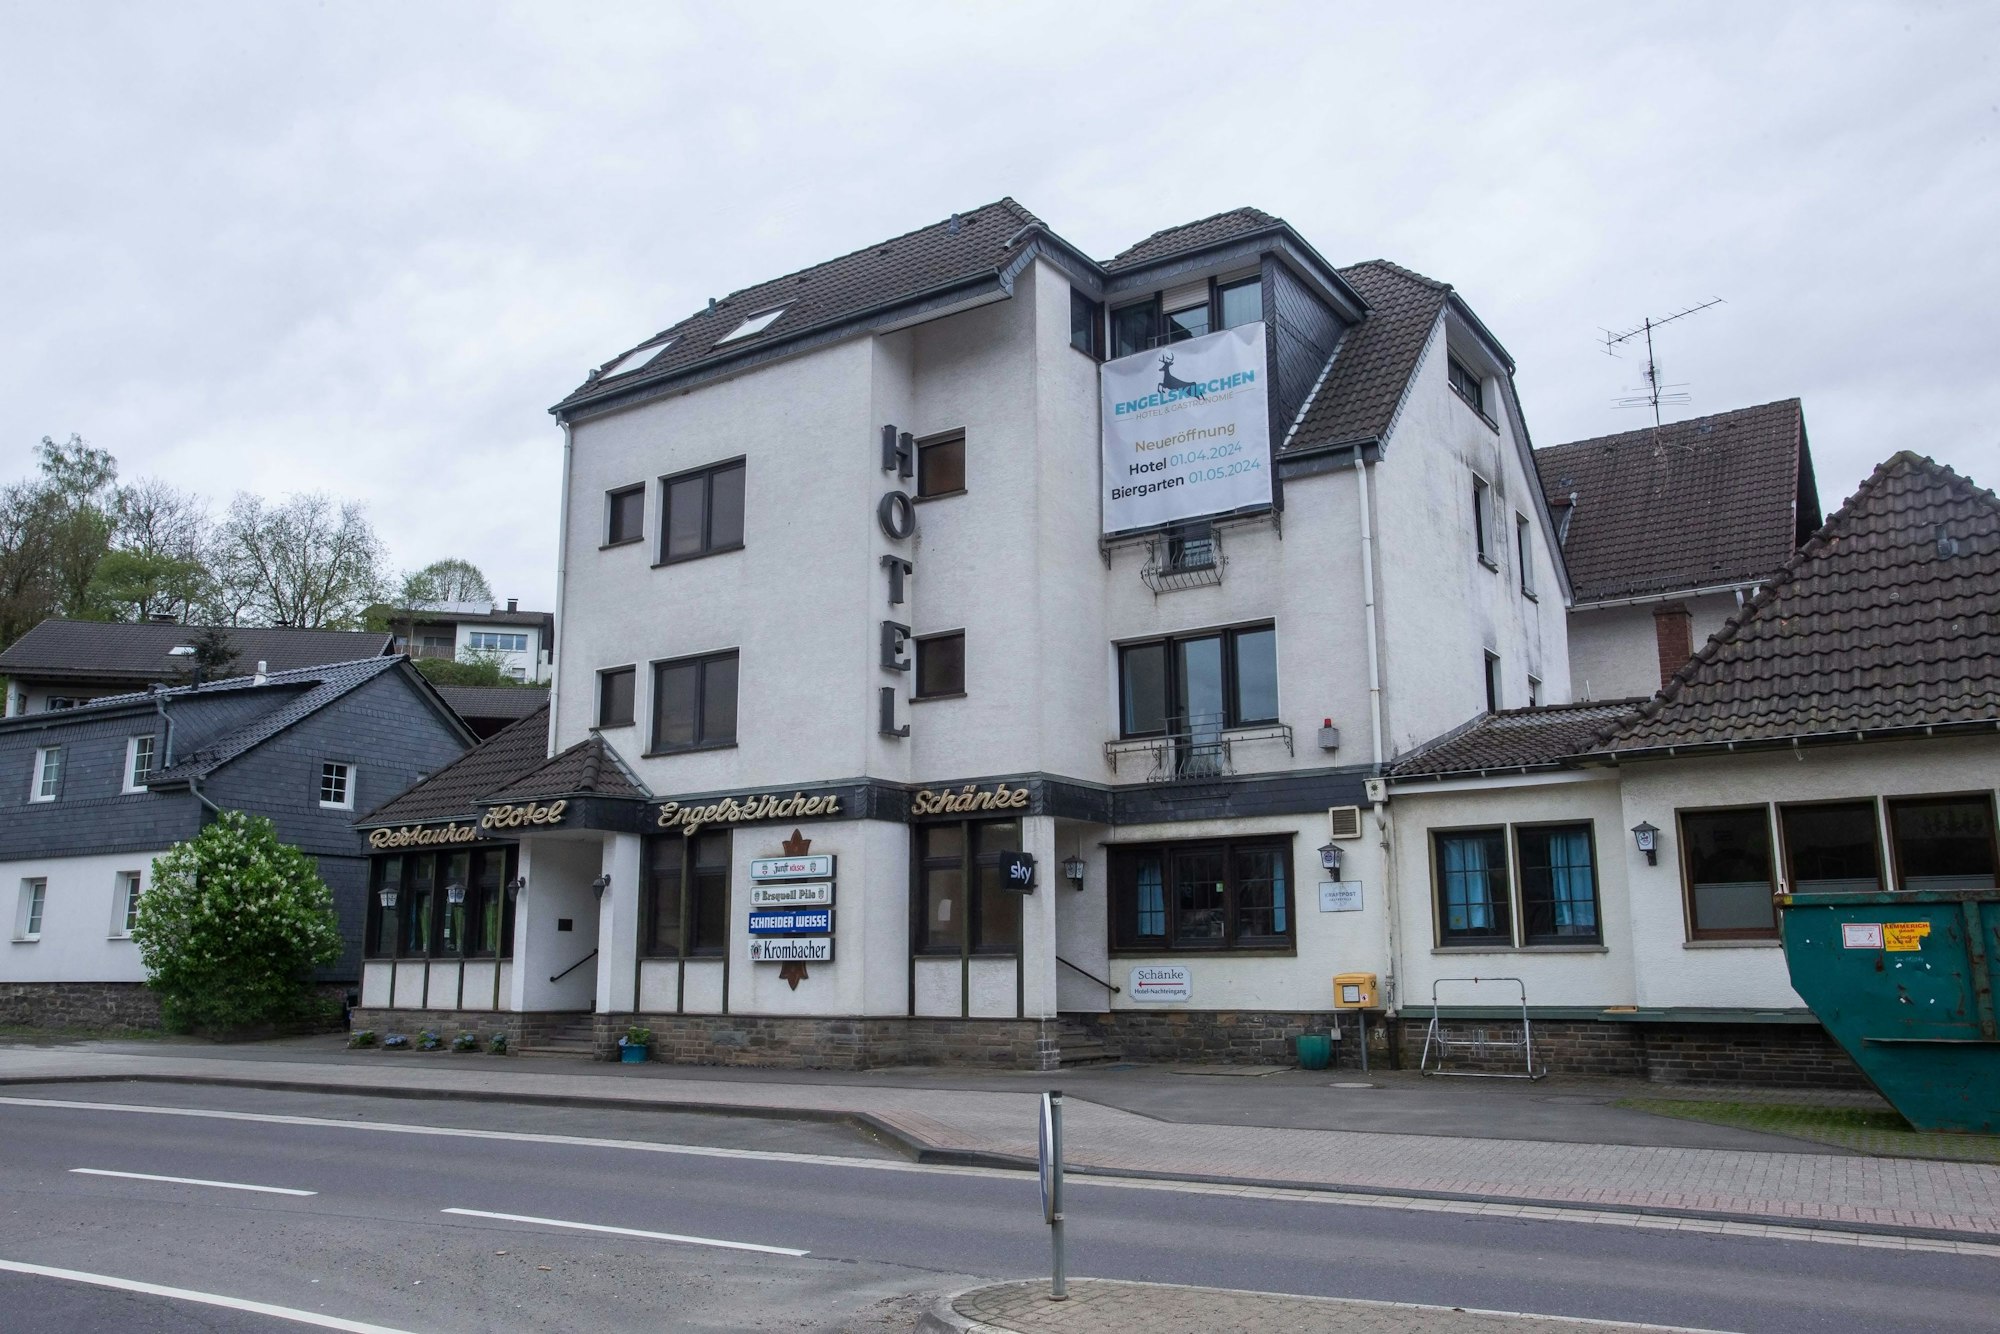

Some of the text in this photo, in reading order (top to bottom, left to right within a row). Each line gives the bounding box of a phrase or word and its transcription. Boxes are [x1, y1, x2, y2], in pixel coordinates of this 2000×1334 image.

[1115, 369, 1255, 416] ENGELSKIRCHEN
[1135, 391, 1234, 421] HOTEL & GASTRONOMIE
[1135, 422, 1236, 453] Neueröffnung
[1129, 440, 1242, 476] Hotel 01.04.2024
[1111, 458, 1261, 500] Biergarten 01.05.2024
[878, 423, 917, 738] HOTEL
[481, 799, 568, 830] Hotel
[657, 792, 840, 836] Engelskirchen
[911, 783, 1029, 815] Schänke
[1010, 861, 1032, 884] sky
[798, 888, 816, 900] Pils
[750, 915, 827, 929] SCHNEIDER WEISSE
[764, 940, 826, 959] Krombacher
[1138, 969, 1184, 980] Schänke
[1134, 988, 1187, 996] Hotel-Nachteingang
